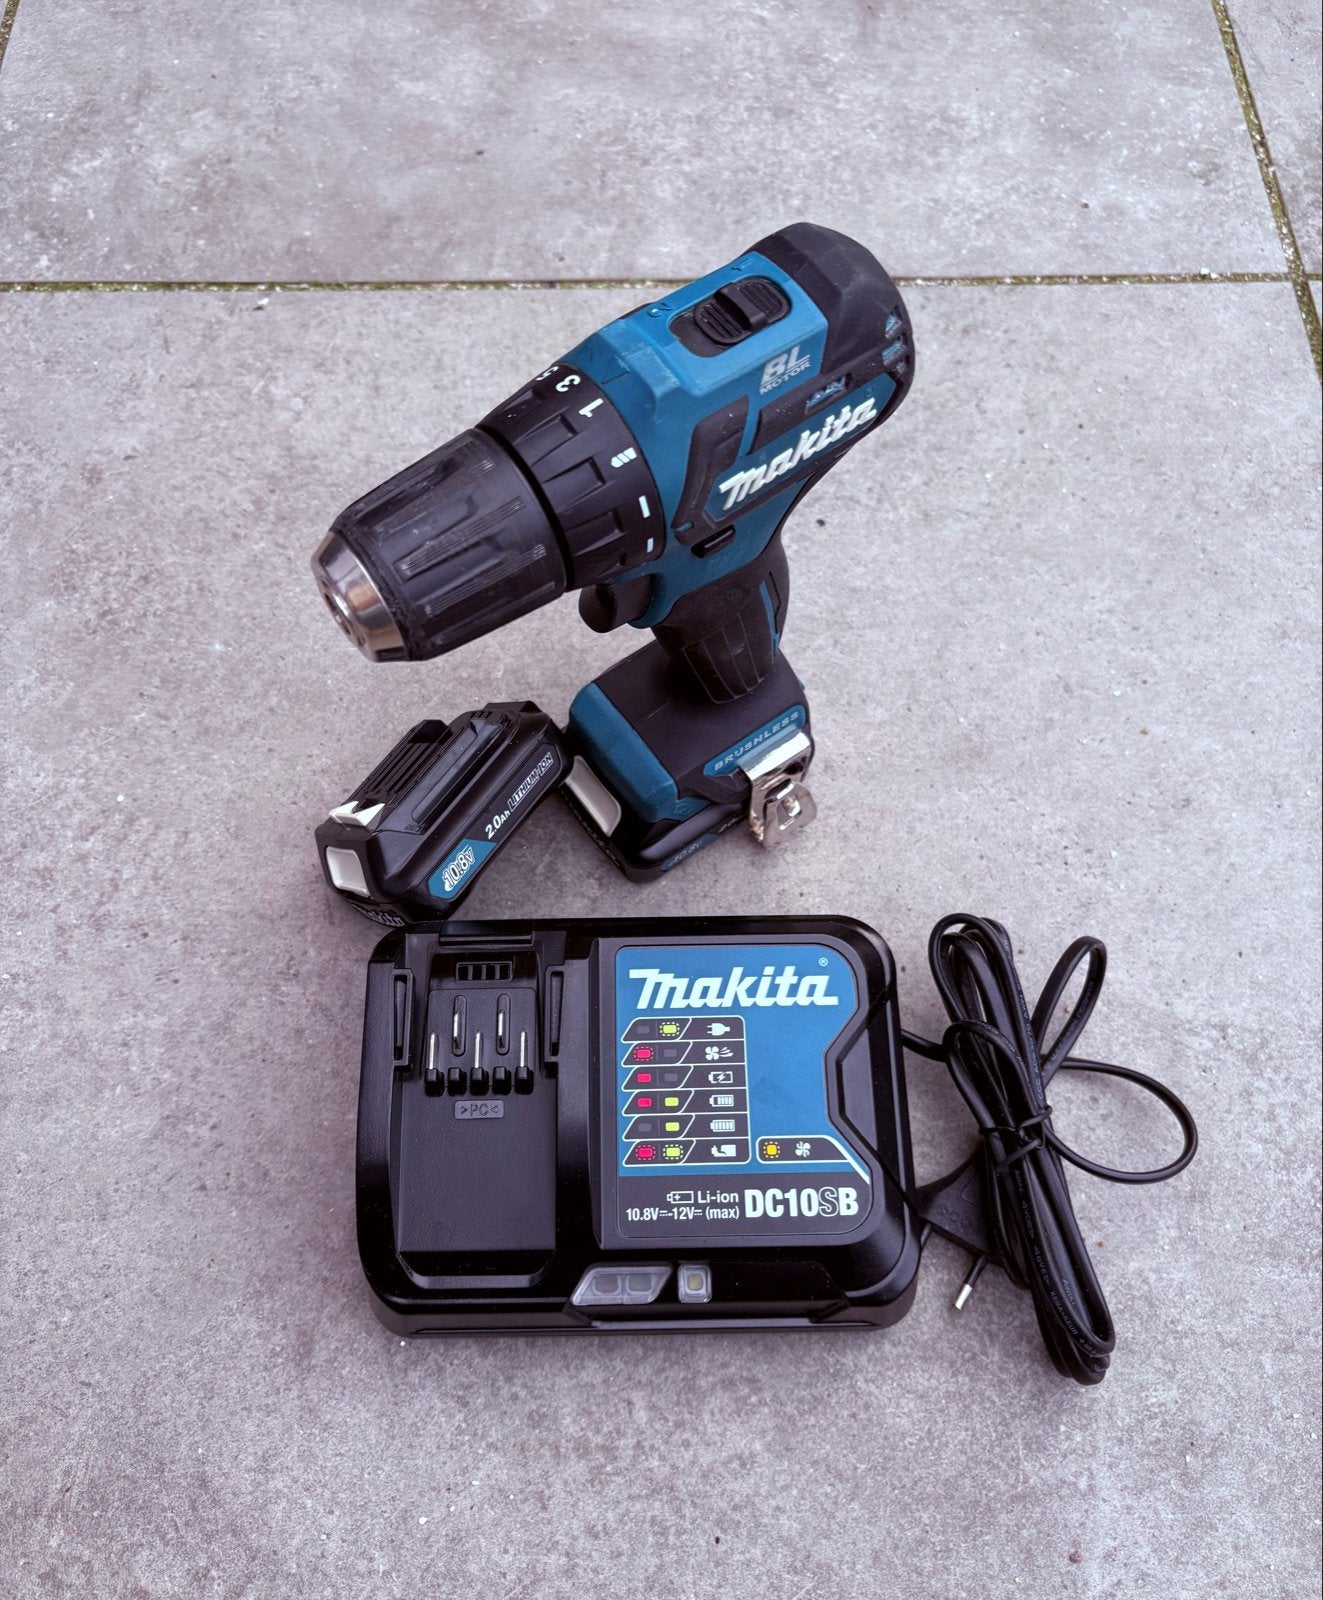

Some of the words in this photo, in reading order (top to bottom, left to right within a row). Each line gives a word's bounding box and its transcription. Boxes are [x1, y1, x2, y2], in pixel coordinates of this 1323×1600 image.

[760, 361, 811, 395] MOTOR
[761, 344, 811, 385] BL
[555, 374, 581, 392] 3
[578, 398, 603, 418] 1
[718, 397, 879, 511] Makita
[714, 711, 799, 770] BRUSHLESS
[485, 809, 511, 839] 2.0Ah
[507, 752, 554, 813] LITHIUM-ION
[629, 966, 839, 1010] Makita
[697, 1191, 739, 1203] Li-ion
[705, 1207, 740, 1221] (max)
[745, 1187, 859, 1217] DC10SB
